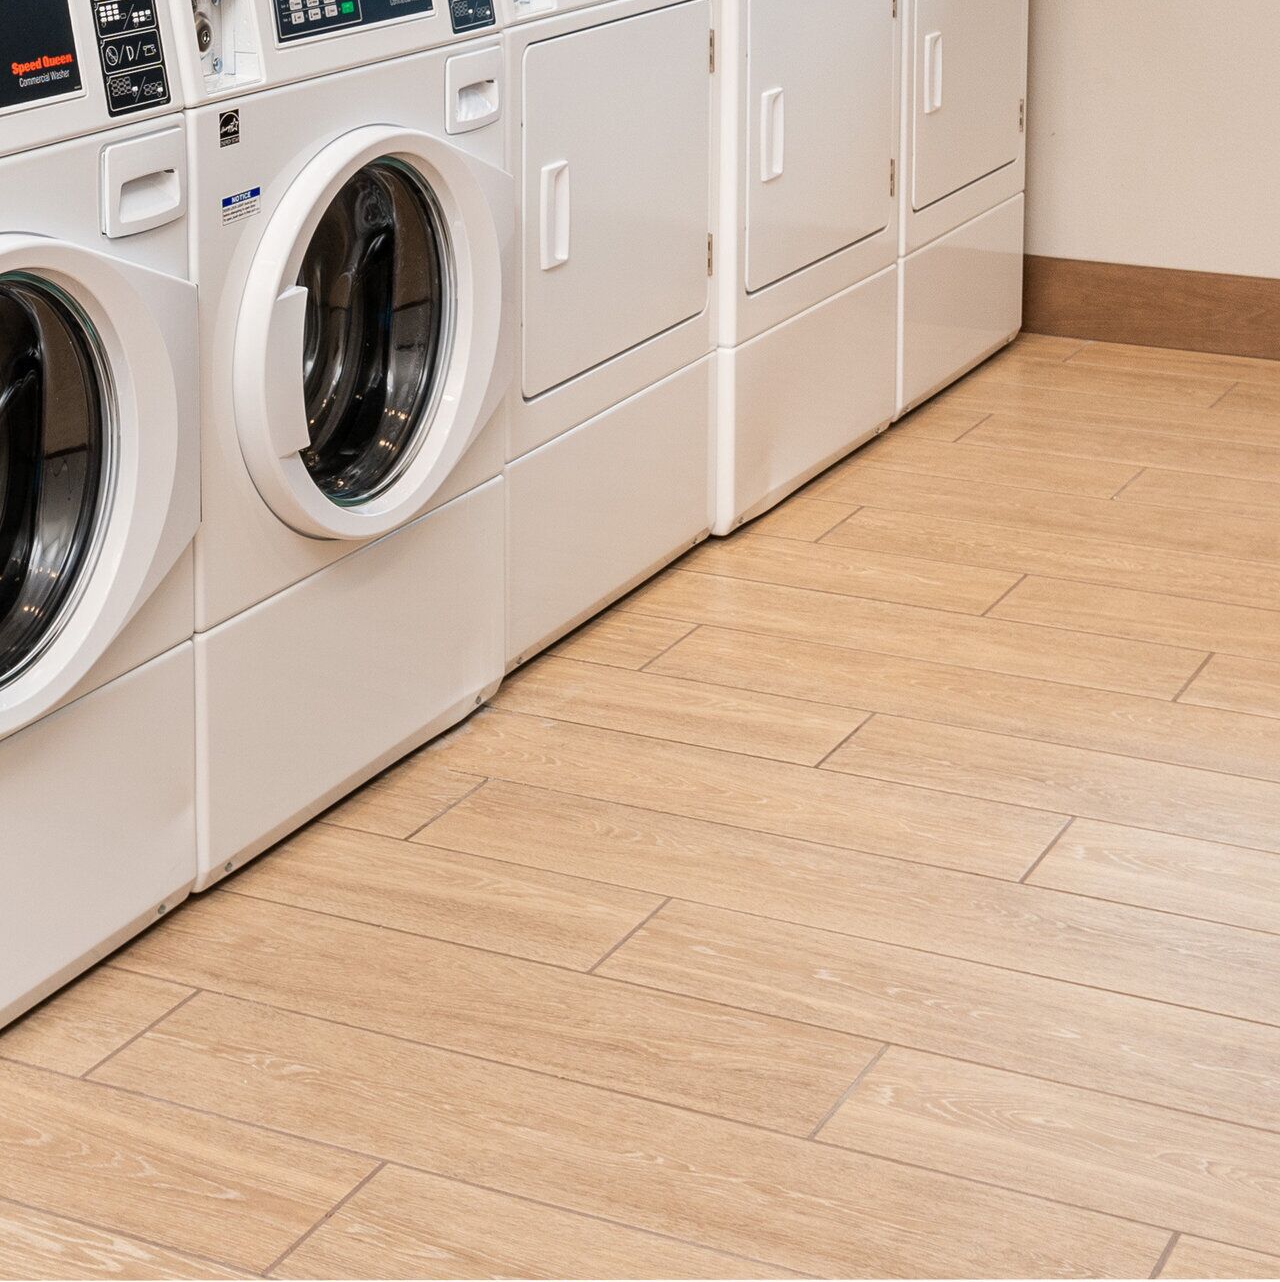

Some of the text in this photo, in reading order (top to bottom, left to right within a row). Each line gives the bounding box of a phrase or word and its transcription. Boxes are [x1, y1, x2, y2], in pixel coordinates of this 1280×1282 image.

[11, 53, 73, 76] Speed Queen
[19, 69, 70, 87] Commercial Washer
